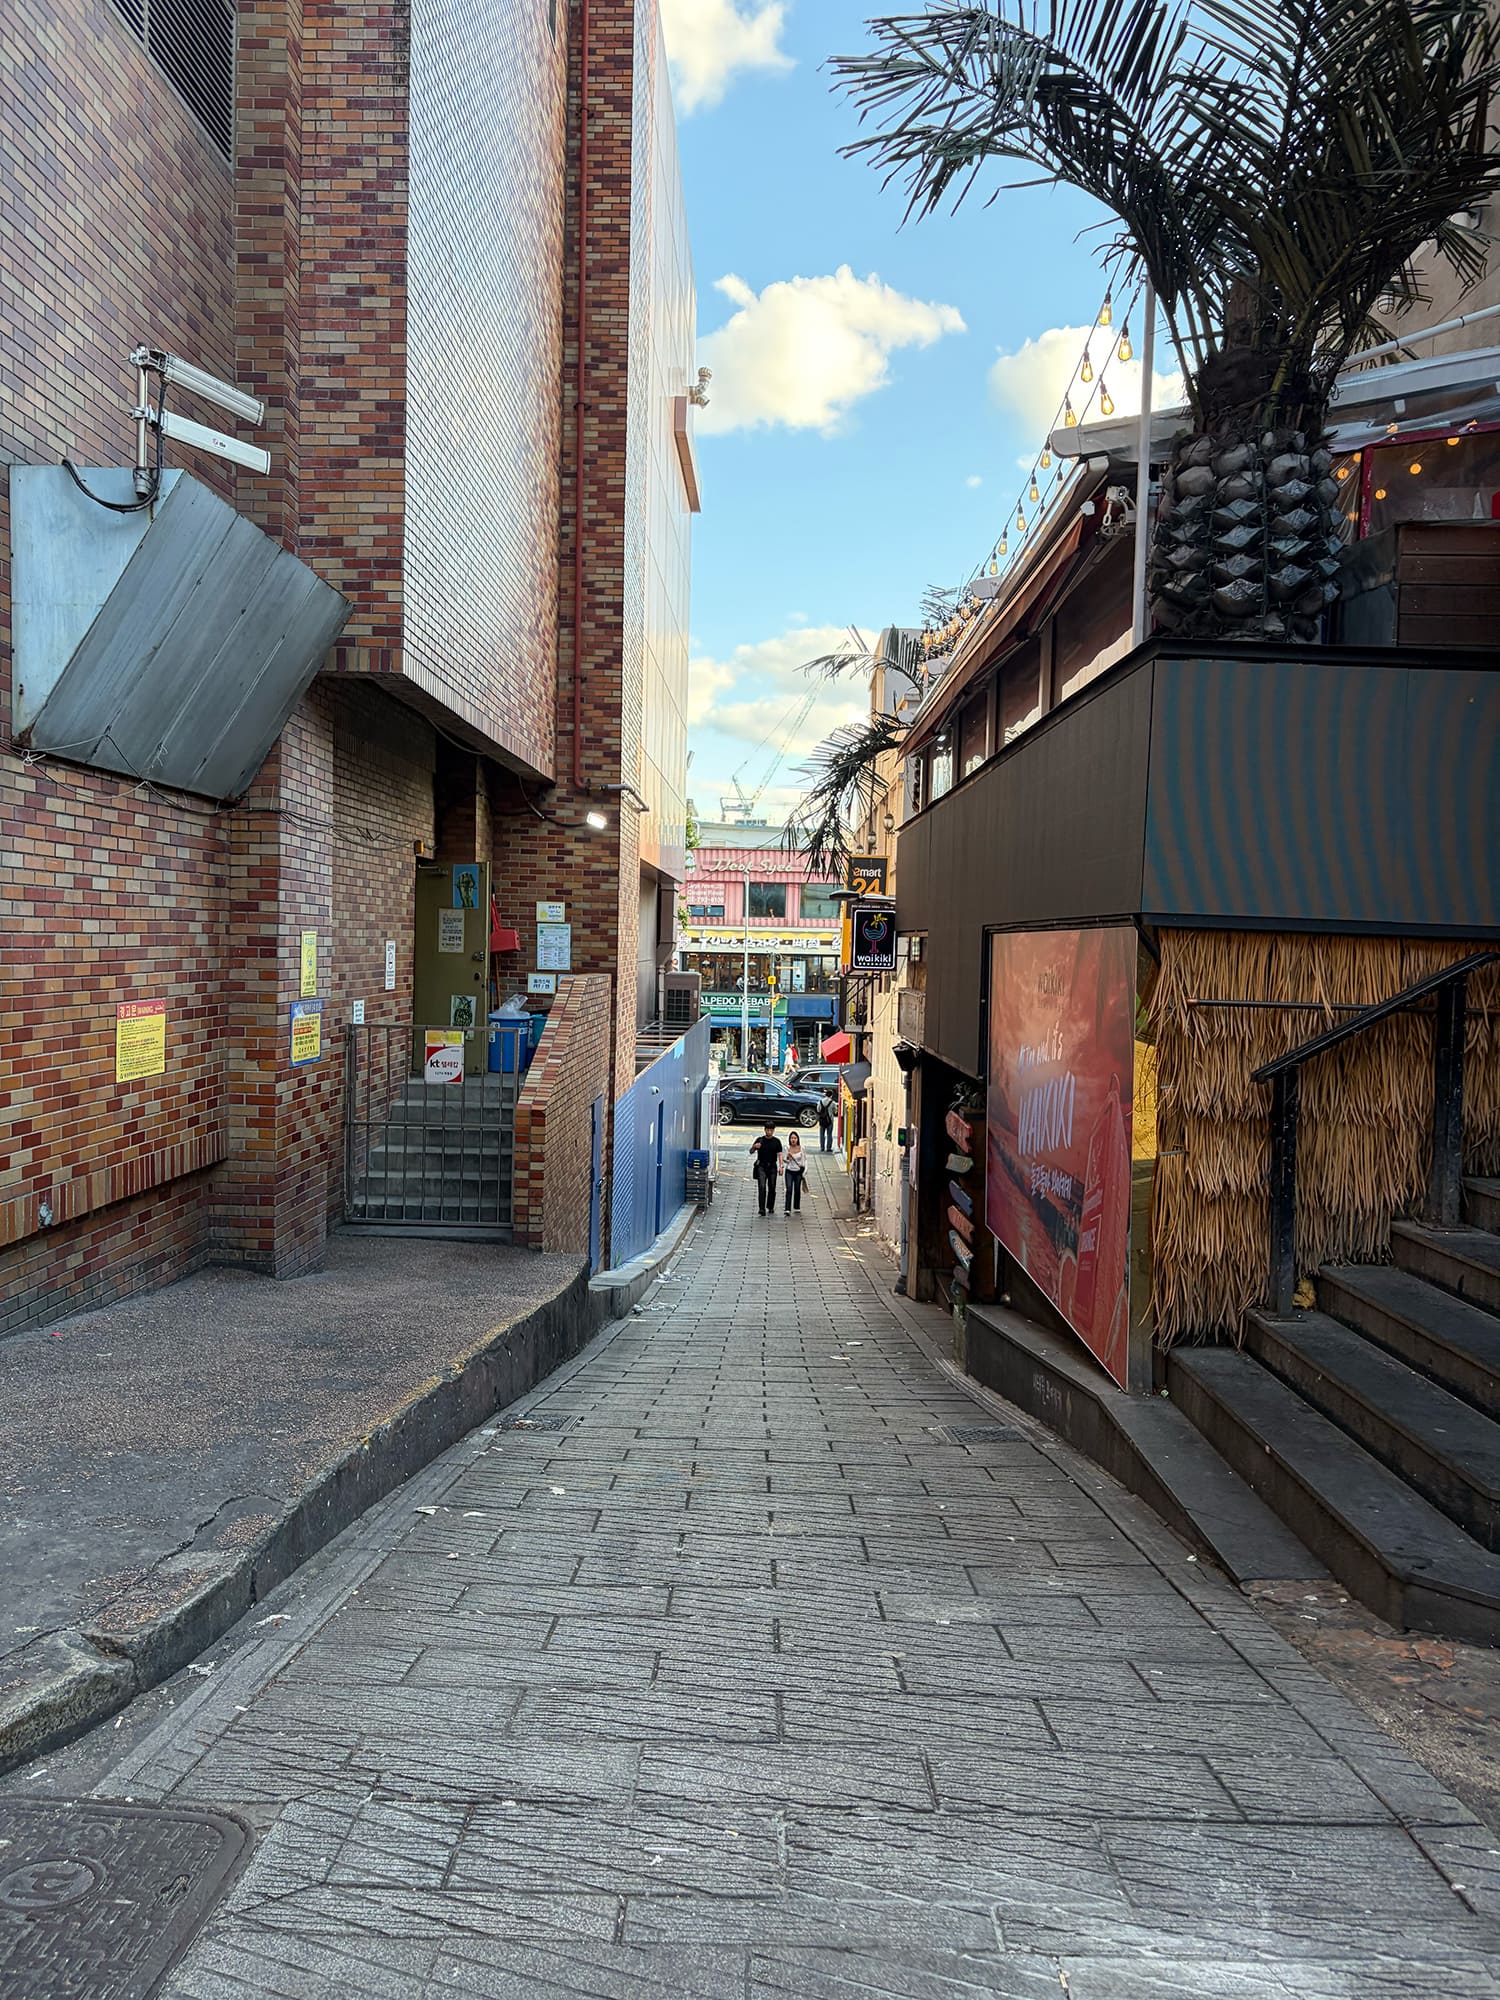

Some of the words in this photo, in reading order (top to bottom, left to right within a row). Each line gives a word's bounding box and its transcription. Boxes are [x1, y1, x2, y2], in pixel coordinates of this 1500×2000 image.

[853, 867, 881, 877] emart
[851, 878, 880, 894] 24
[857, 953, 892, 963] waikiki
[430, 1059, 440, 1068] kt
[1017, 1069, 1076, 1159] WAIKIKI
